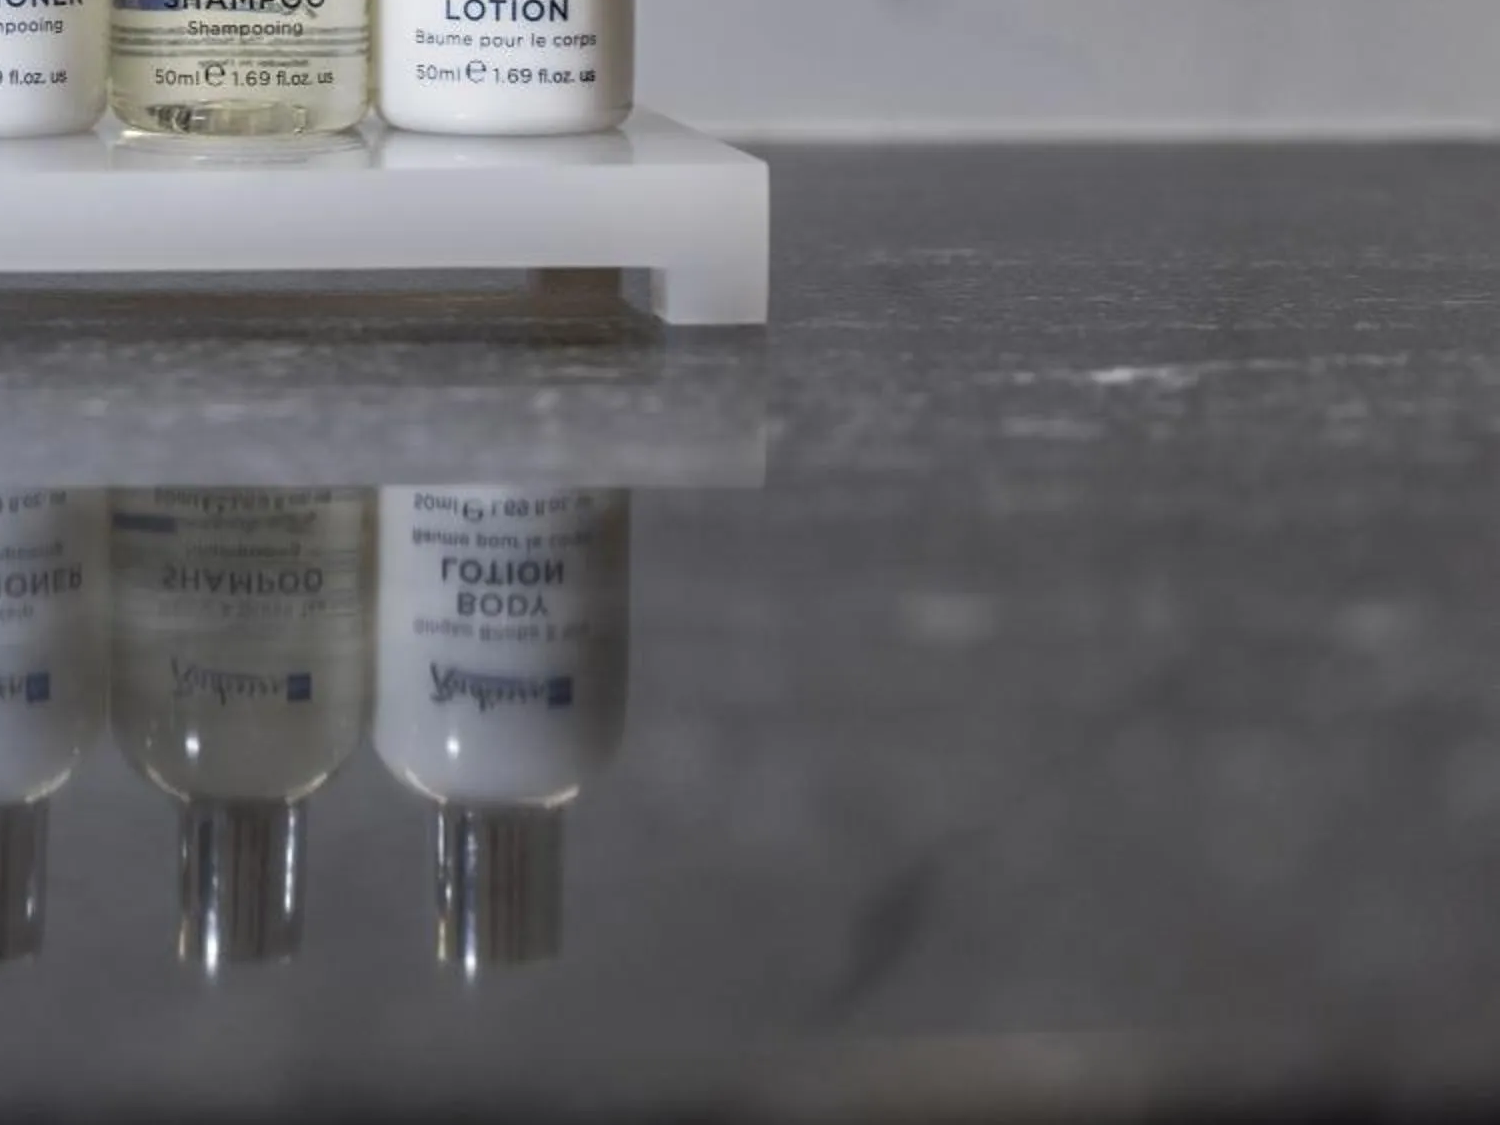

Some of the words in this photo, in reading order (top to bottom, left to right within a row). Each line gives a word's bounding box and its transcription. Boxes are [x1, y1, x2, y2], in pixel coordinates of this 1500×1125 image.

[187, 21, 304, 37] Shampooing
[414, 30, 473, 46] Baume
[480, 34, 524, 48] pour
[531, 32, 547, 47] le
[553, 33, 597, 48] corps
[155, 69, 200, 86] 50ml
[232, 70, 271, 86] 1.69
[317, 70, 334, 84] us
[415, 64, 461, 83] 50ml
[493, 69, 532, 84] 1.69
